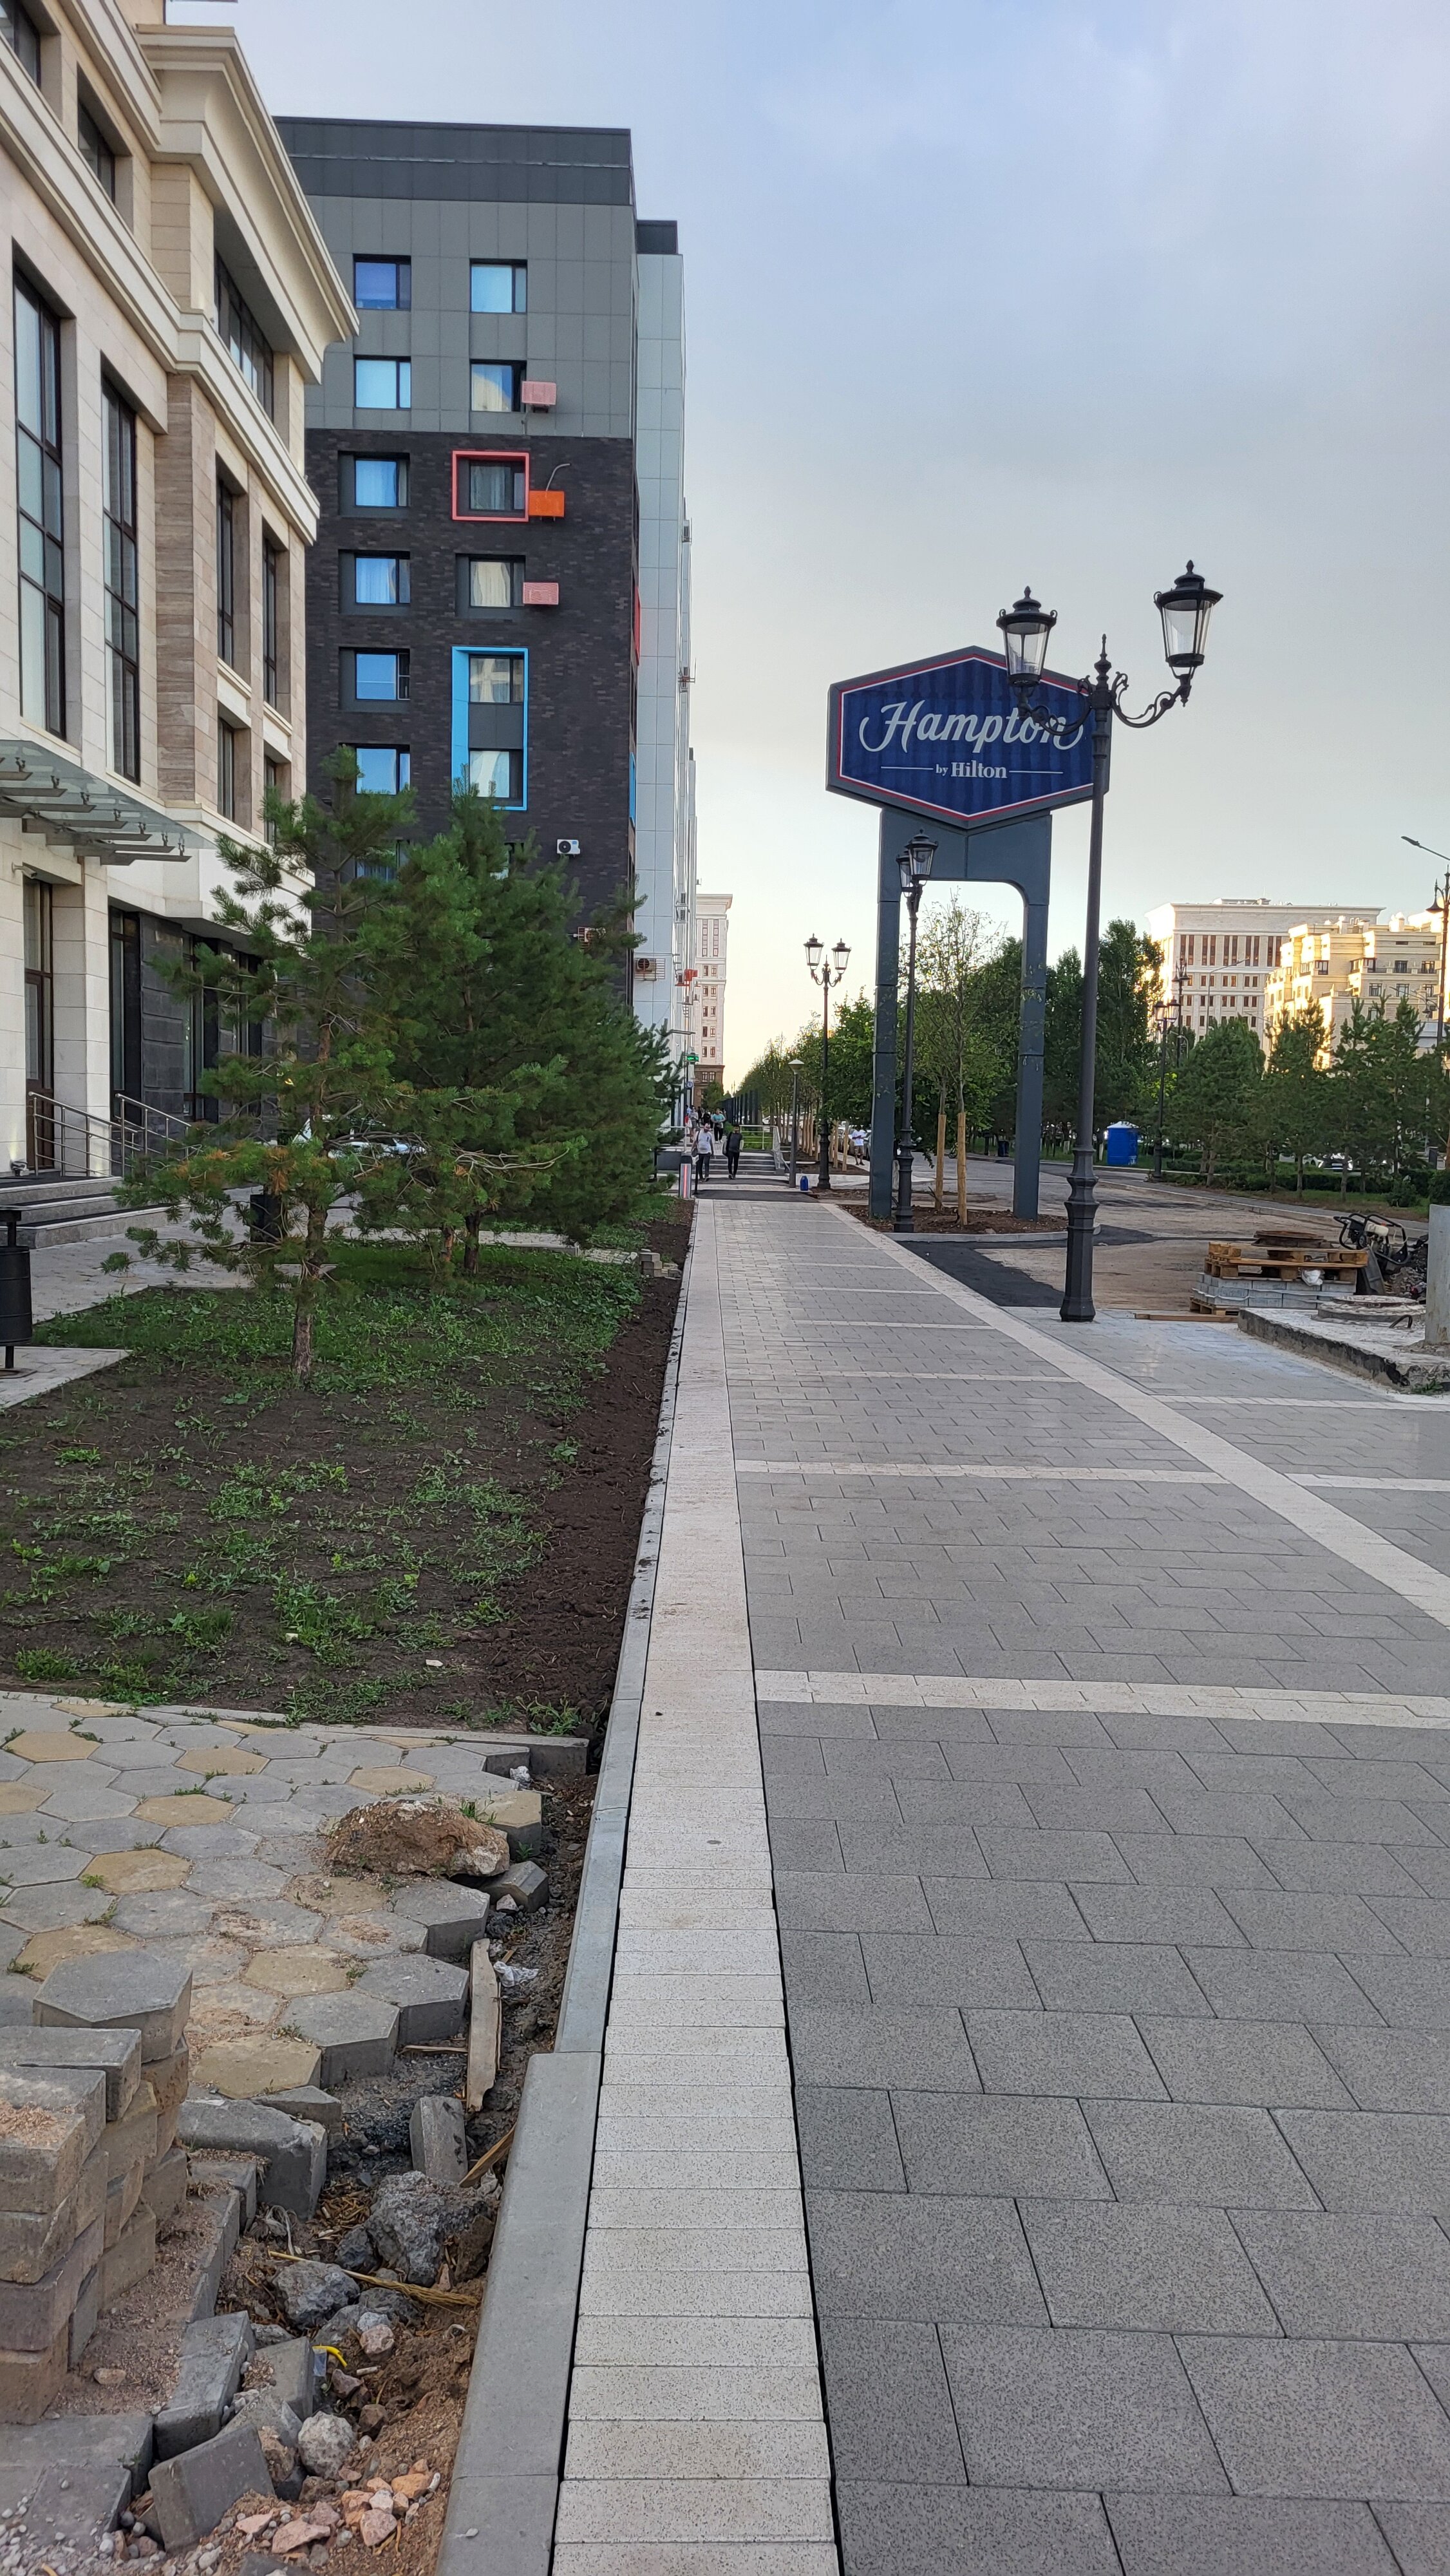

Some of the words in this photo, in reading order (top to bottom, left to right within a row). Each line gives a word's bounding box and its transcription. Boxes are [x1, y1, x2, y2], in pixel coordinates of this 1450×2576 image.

[859, 699, 1083, 753] Hampton
[936, 764, 948, 776] by
[950, 760, 1007, 778] Hilton
